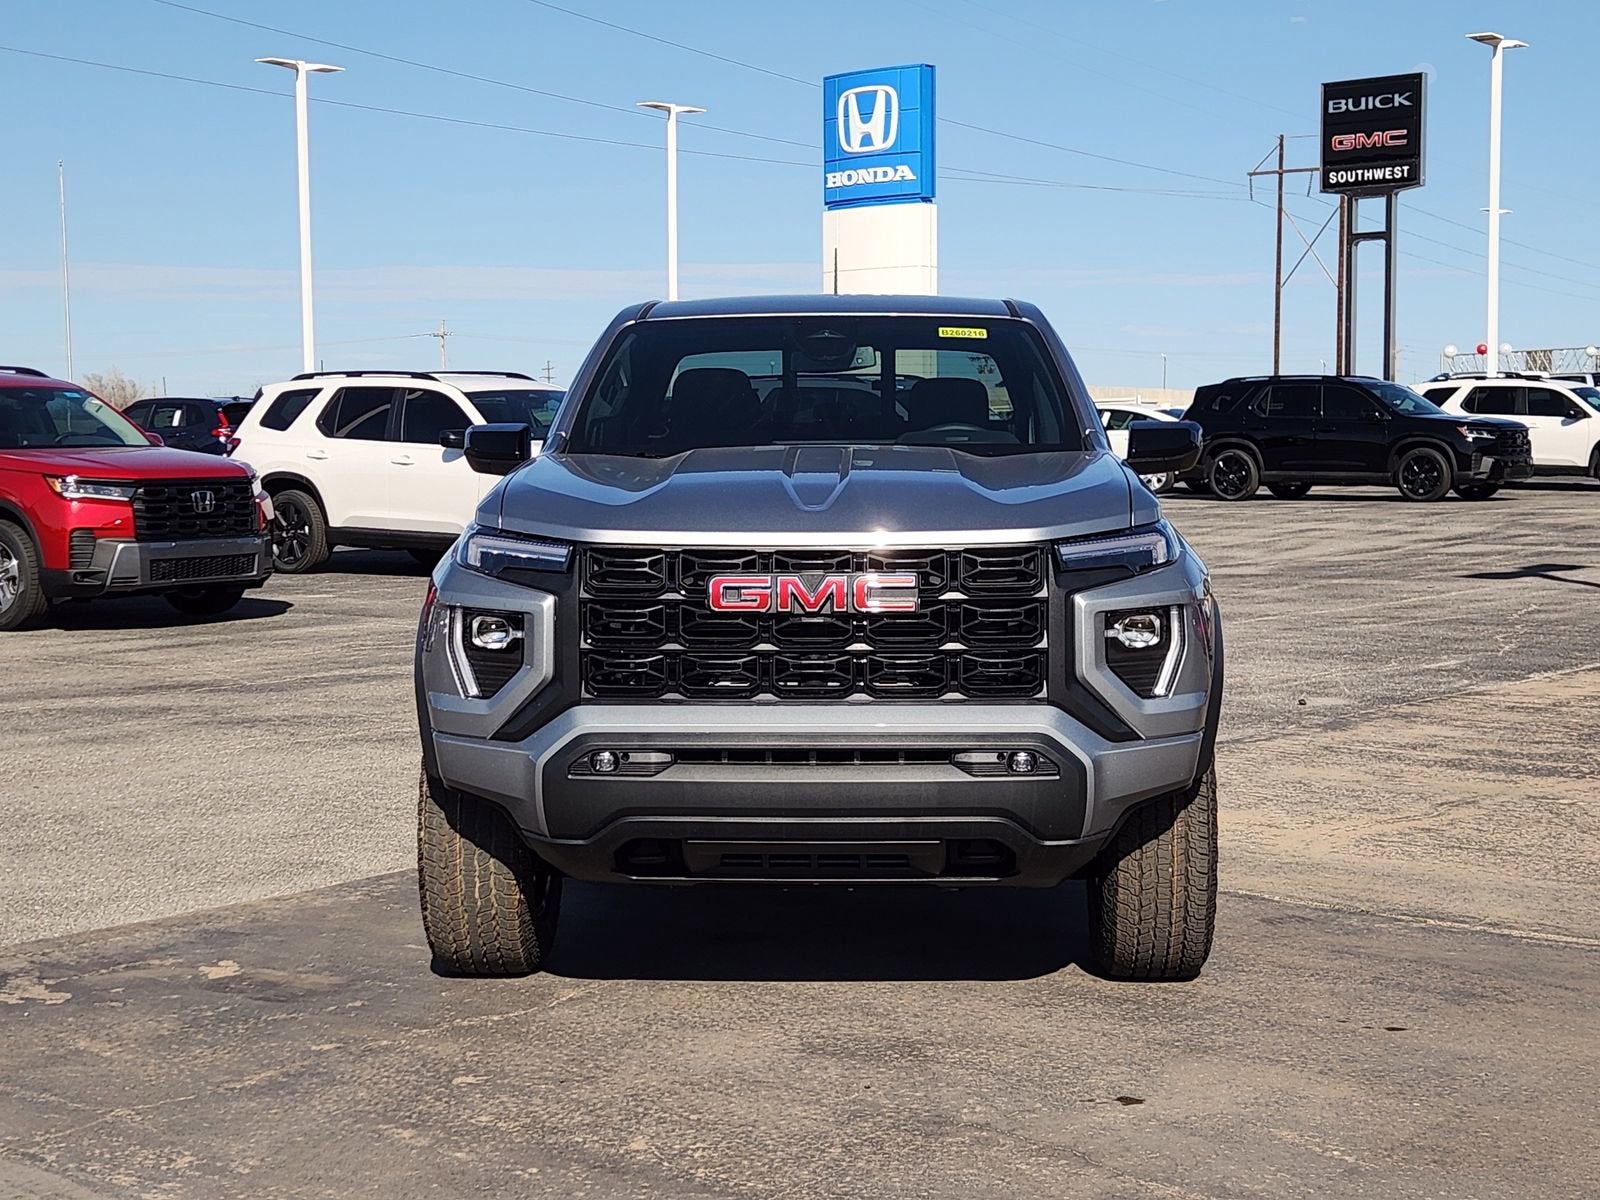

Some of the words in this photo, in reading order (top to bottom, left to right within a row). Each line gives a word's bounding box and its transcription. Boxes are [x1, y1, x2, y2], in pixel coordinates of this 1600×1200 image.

[1328, 92, 1413, 113] BUICK
[1331, 129, 1408, 151] GMC
[825, 165, 917, 188] HONDA
[1328, 165, 1410, 184] SOUTHWEST
[941, 328, 985, 337] B260216
[709, 575, 917, 613] GMC
